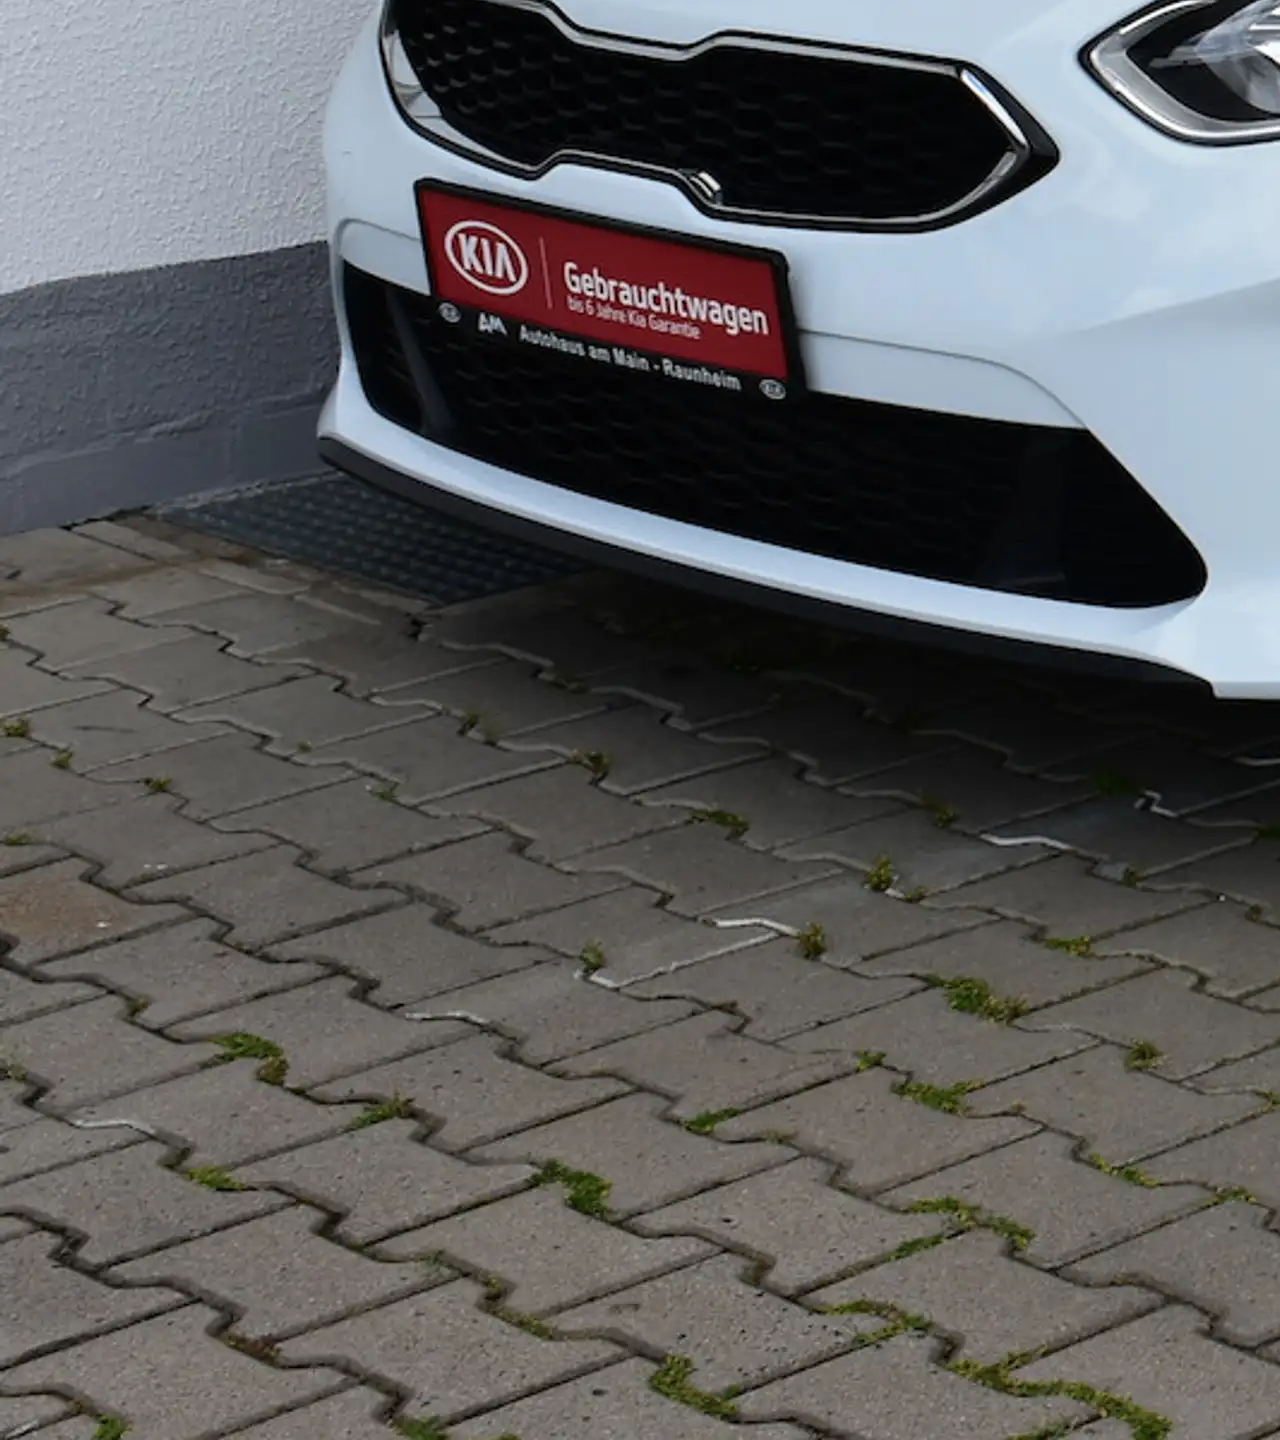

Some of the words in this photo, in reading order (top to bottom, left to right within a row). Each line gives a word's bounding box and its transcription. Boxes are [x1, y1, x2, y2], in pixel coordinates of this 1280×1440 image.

[458, 232, 517, 284] KIA
[564, 262, 768, 335] Gebrauchtwagen
[628, 310, 647, 329] Kia
[648, 313, 701, 340] Garantie
[519, 324, 586, 356] Autohaus
[588, 345, 611, 362] am
[613, 348, 650, 372] Main
[662, 358, 742, 391] Raunheim
